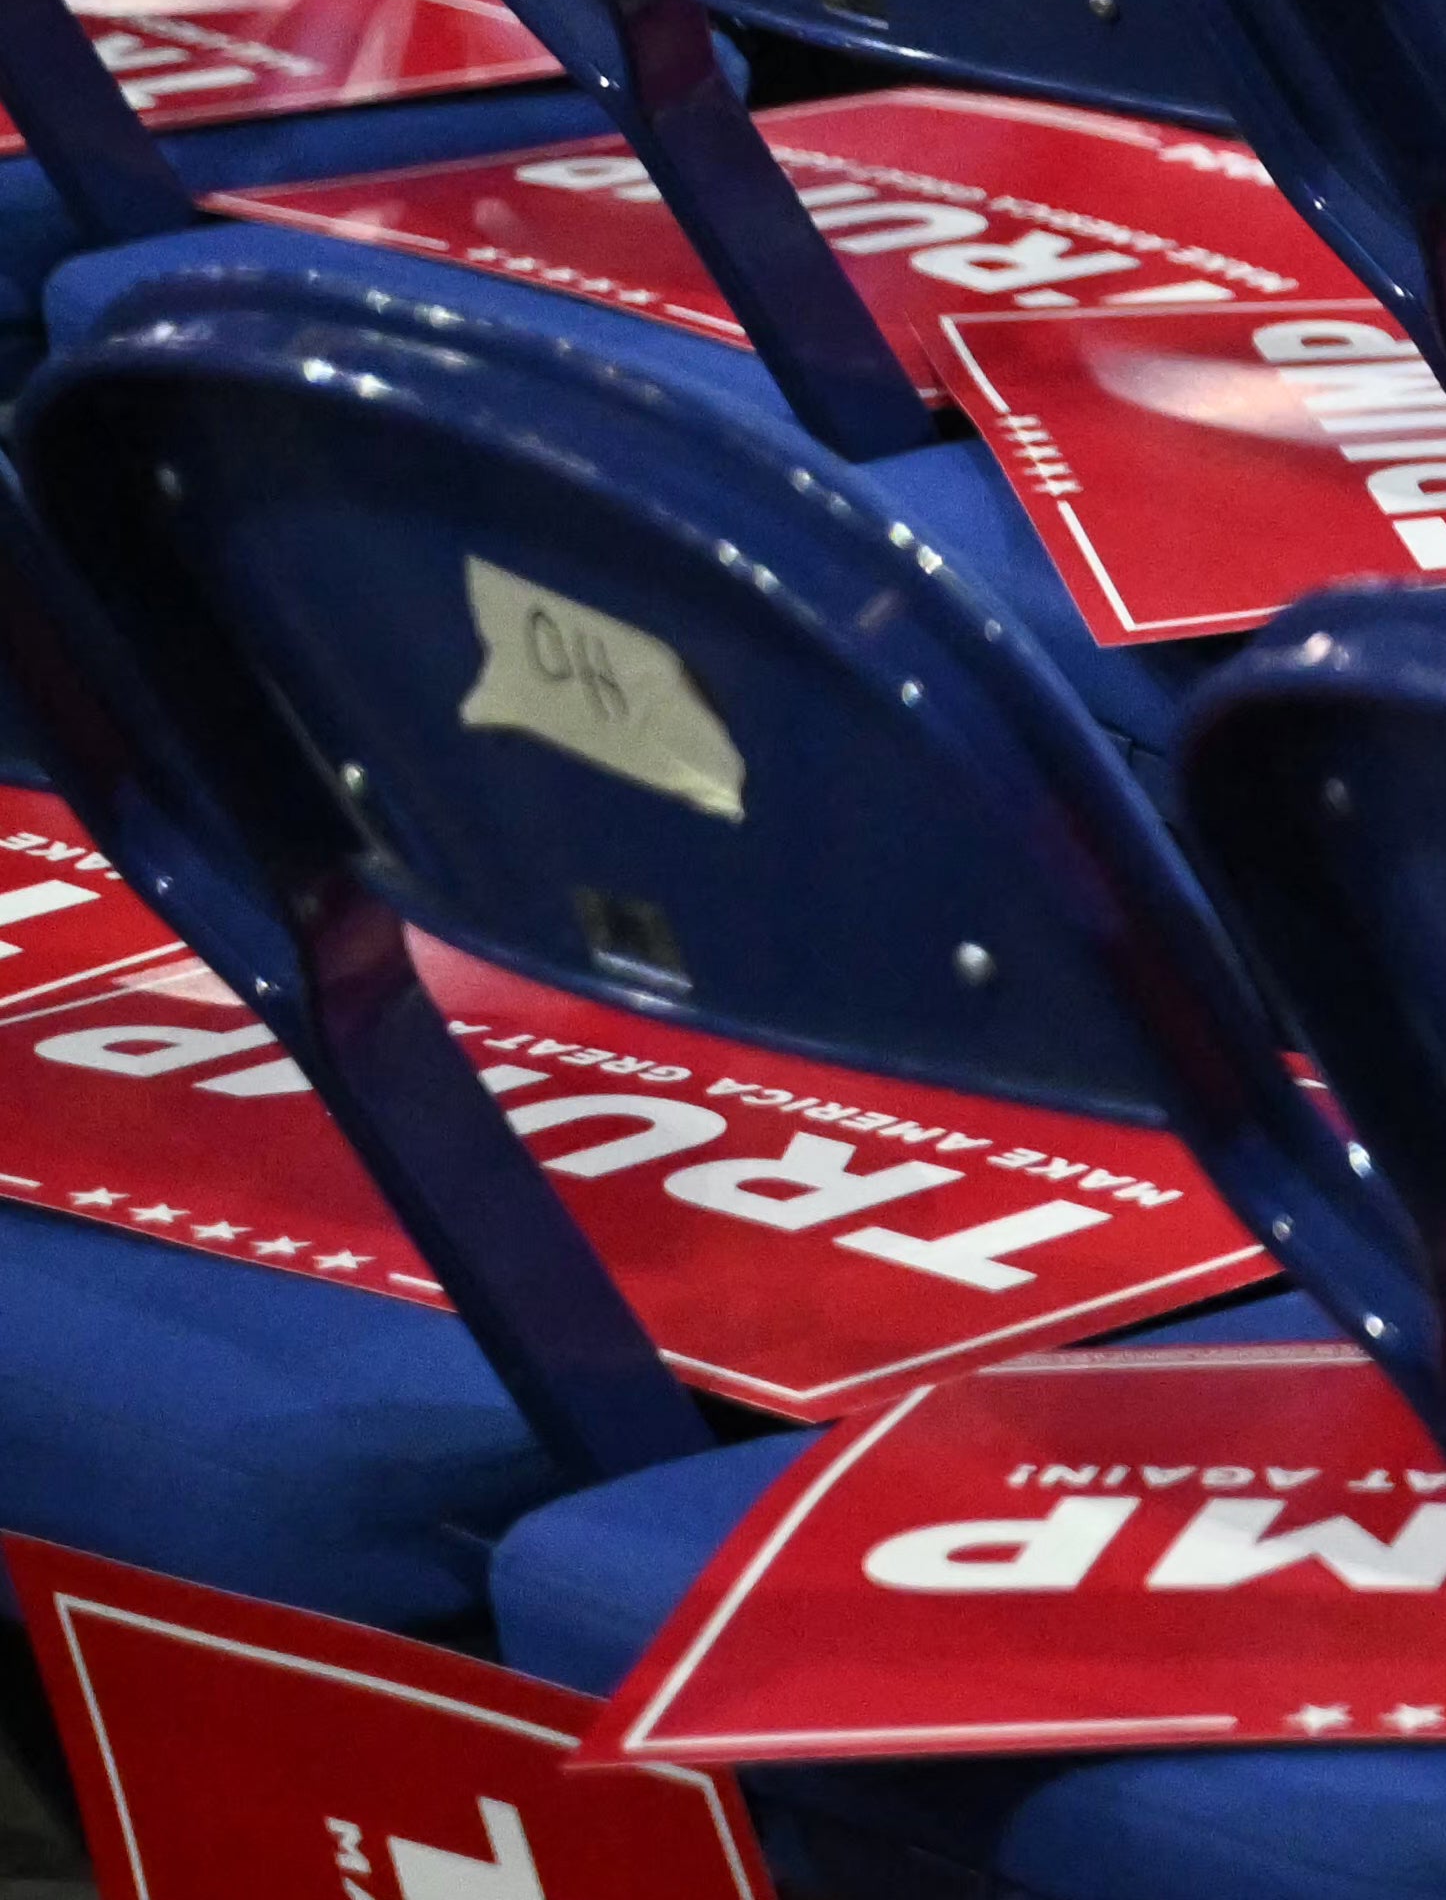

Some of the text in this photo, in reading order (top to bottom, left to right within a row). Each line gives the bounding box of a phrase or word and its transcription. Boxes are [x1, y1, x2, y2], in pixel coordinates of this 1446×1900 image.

[526, 607, 630, 721] OH
[0, 831, 124, 880] AKE
[485, 1024, 1186, 1209] MAKE AMERICA GREAT
[1003, 1462, 1321, 1491] AGAIN!
